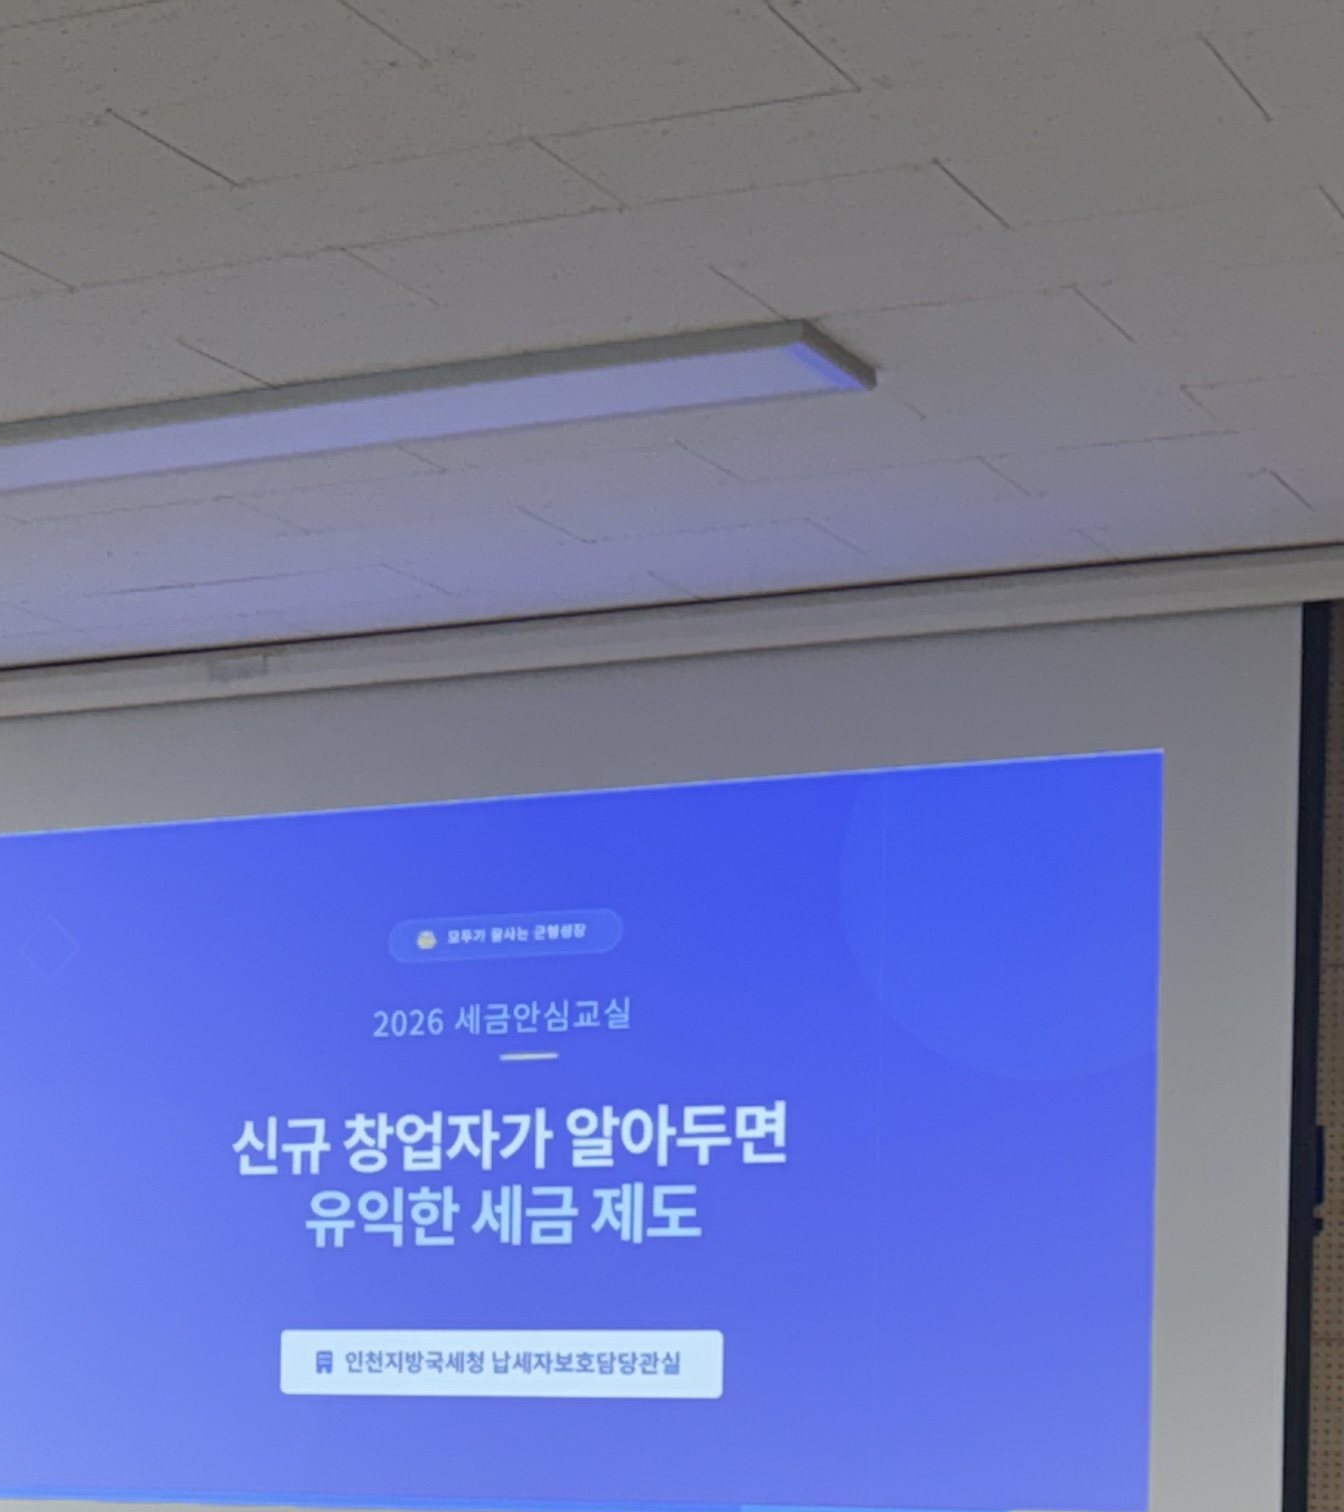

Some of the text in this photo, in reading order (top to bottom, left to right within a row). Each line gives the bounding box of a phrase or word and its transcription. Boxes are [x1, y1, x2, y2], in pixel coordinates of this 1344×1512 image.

[447, 928, 486, 945] 모두가
[372, 996, 631, 1038] 2026 세금안심교실
[231, 1099, 788, 1176] 신규 창업자가 알아두면
[304, 1181, 703, 1248] 유익한 세금 제도
[344, 1349, 682, 1376] 인천지방국세청 납세자보호담당관실
